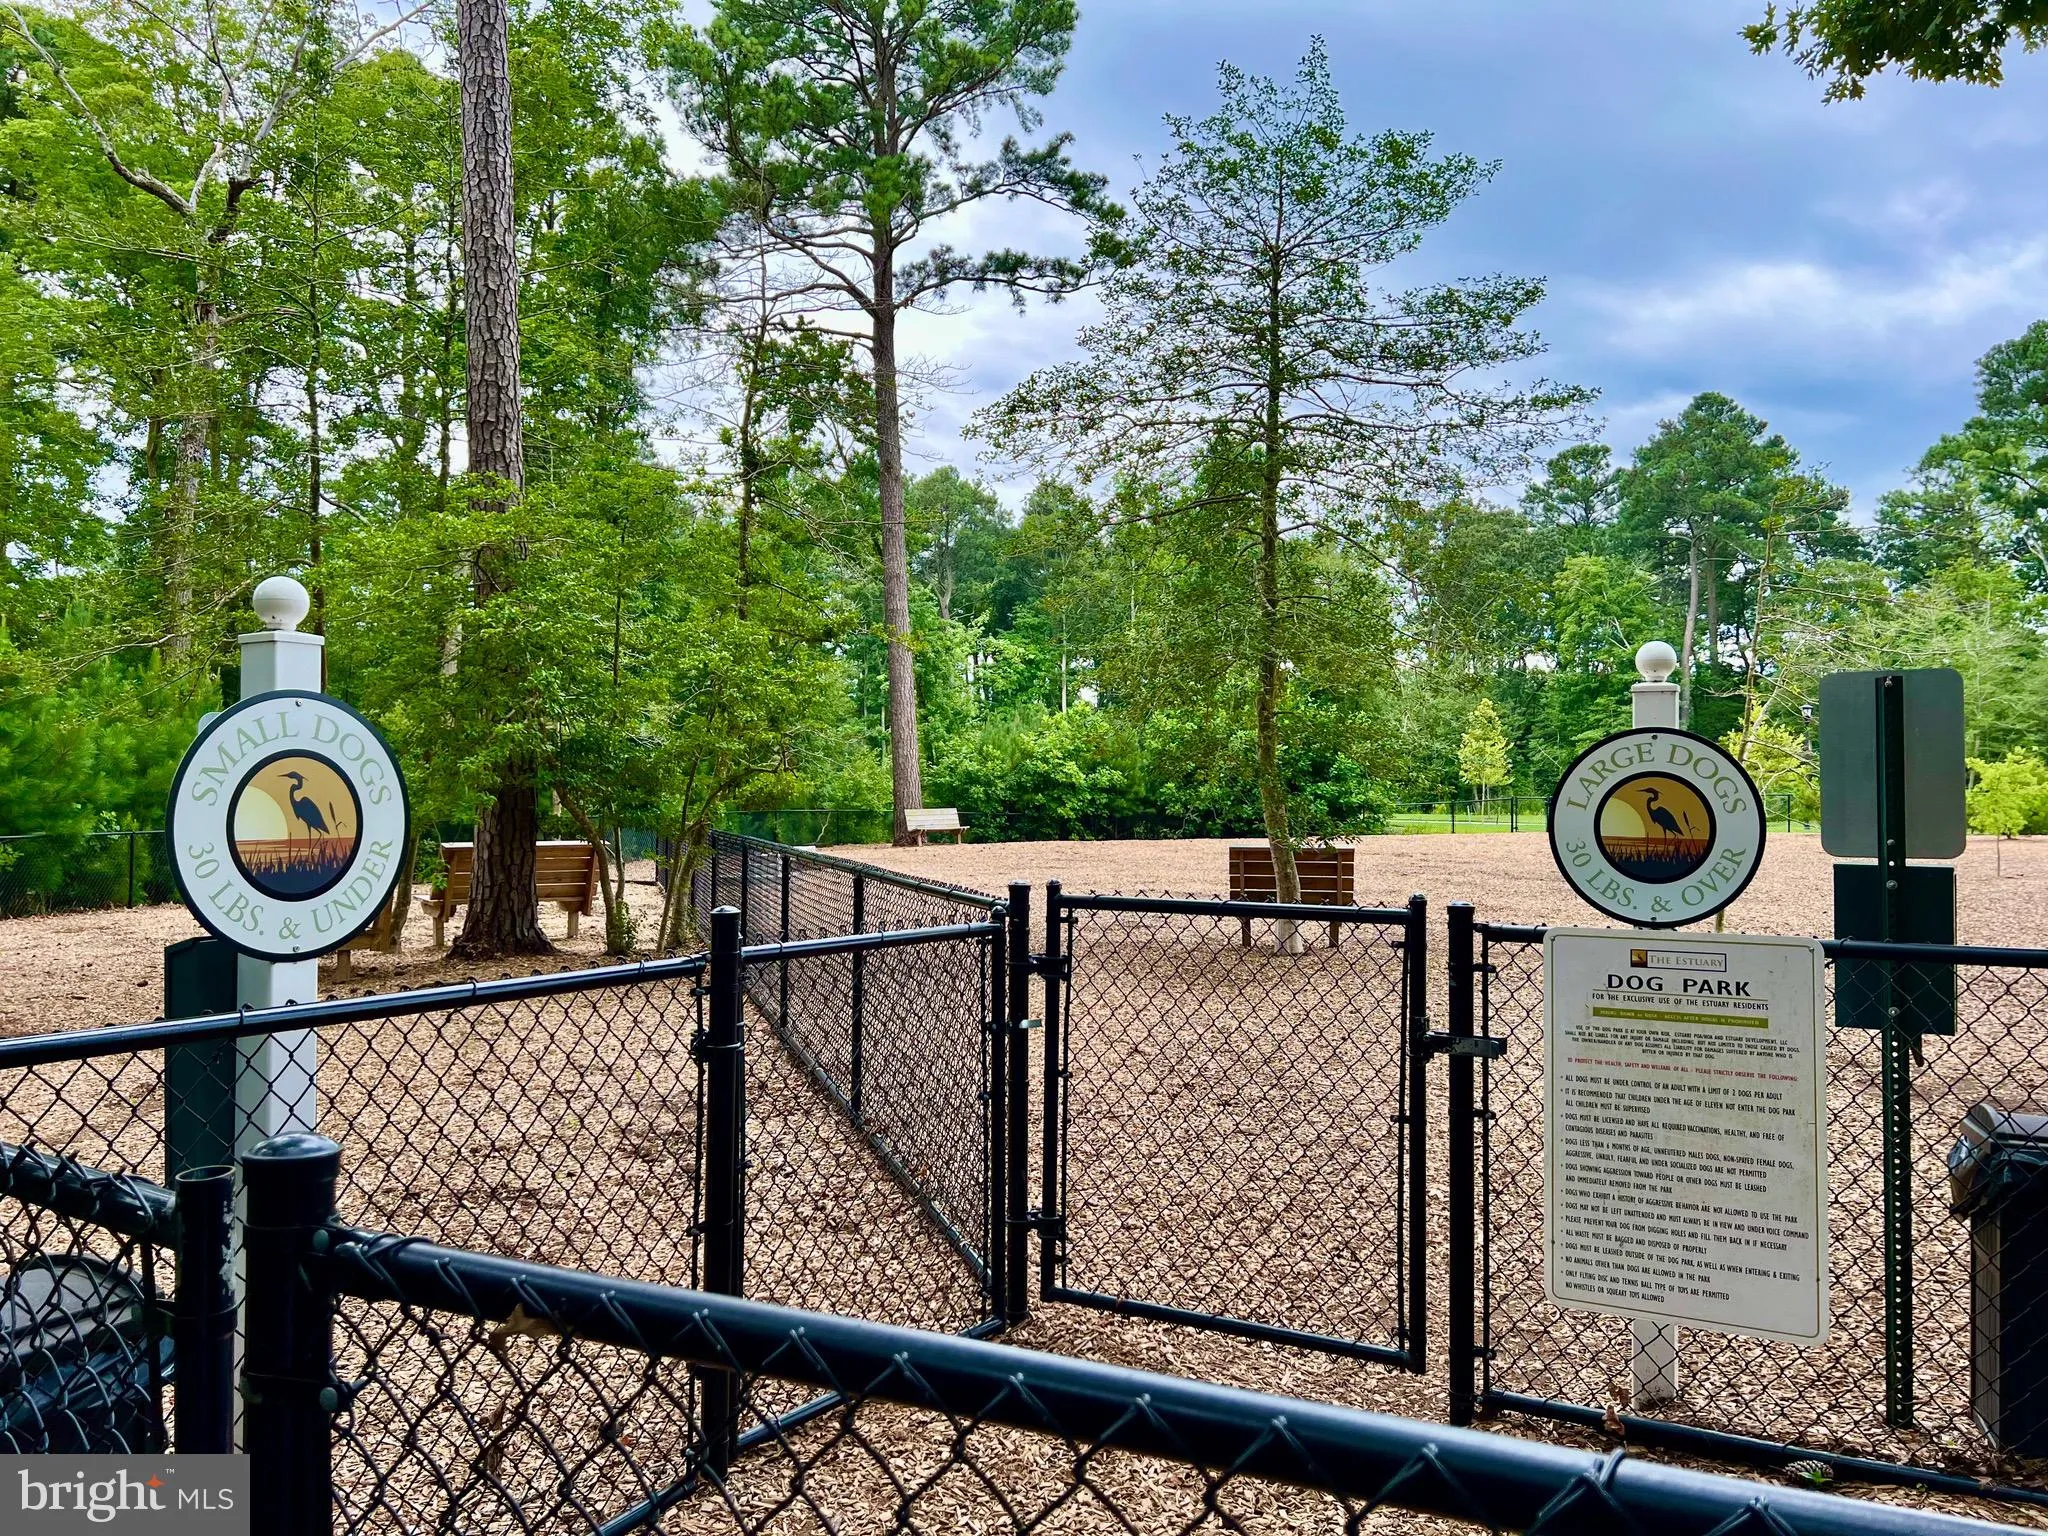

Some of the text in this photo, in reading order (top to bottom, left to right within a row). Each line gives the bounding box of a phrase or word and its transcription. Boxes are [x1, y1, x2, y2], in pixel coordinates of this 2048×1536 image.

[191, 711, 392, 806] SMALL DOGS
[1567, 742, 1747, 814] LARGE DOGS
[1566, 837, 1747, 913] 30 LBS. & OVER
[189, 840, 393, 940] 30 LBS. & UNDER
[1649, 954, 1724, 968] THE ESTUARY
[1607, 973, 1750, 997] DOG PARK
[1622, 994, 1654, 1003] EXCLUSIVE
[1686, 998, 1697, 1006] THE
[1702, 999, 1729, 1008] ESTUARY
[1733, 1002, 1768, 1010] RESIDENTS
[1577, 1088, 1612, 1098] RECOMMENDED
[1614, 1092, 1625, 1100] THAT
[1627, 1093, 1651, 1102] CHILDREN
[1653, 1096, 1670, 1104] UNDER
[1671, 1097, 1681, 1105] THE
[1683, 1098, 1693, 1106] AGE
[1695, 1099, 1701, 1107] OF
[1704, 1100, 1723, 1109] ELEVEN
[1725, 1102, 1735, 1110] NOT
[1737, 1103, 1754, 1112] ENTER
[1756, 1105, 1765, 1113] THE
[1768, 1106, 1779, 1114] DOG
[1782, 1108, 1795, 1116] PARK
[1589, 1076, 1601, 1084] MUST
[1612, 1078, 1629, 1086] UNDER
[1630, 1079, 1652, 1088] CONTROL
[1661, 1082, 1669, 1090] AN
[1670, 1083, 1686, 1091] ADULT
[1686, 1084, 1700, 1093] WITH
[1707, 1086, 1720, 1095] LIMIT
[1737, 1089, 1751, 1097] DOGS
[1753, 1090, 1764, 1099] PER
[1765, 1092, 1782, 1100] ADULT
[1575, 1100, 1598, 1108] CHILDREN
[1600, 1102, 1612, 1110] MUST
[1614, 1103, 1620, 1111] BE
[1622, 1104, 1650, 1114] SUPERVISED
[1564, 1112, 1577, 1120] DOGS
[1579, 1113, 1591, 1121] MUST
[1601, 1116, 1623, 1125] LICENSED
[1625, 1118, 1635, 1126] AND
[1637, 1119, 1649, 1127] HAVE
[1661, 1122, 1686, 1132] REQUIRED
[1686, 1124, 1721, 1135] VACCINATIONS,
[1724, 1128, 1747, 1138] HEALTHY,
[1749, 1130, 1760, 1139] AND
[1762, 1132, 1774, 1140] FREE
[1777, 1133, 1784, 1141] OF
[1564, 1137, 1577, 1145] DOGS
[1591, 1140, 1604, 1148] THAN
[1611, 1142, 1631, 1151] MONTHS
[1632, 1144, 1639, 1152] OF
[1653, 1147, 1686, 1157] UNNEUTERED
[1687, 1150, 1703, 1159] MALES
[1705, 1152, 1721, 1162] DOGS,
[1722, 1154, 1754, 1165] NON-SPAYED
[1756, 1158, 1775, 1167] FEMALE
[1778, 1160, 1794, 1170] DOGS,
[1565, 1162, 1577, 1170] DOGS
[1579, 1164, 1601, 1173] SHOWING
[1603, 1166, 1631, 1176] AGGRESSION
[1633, 1170, 1653, 1179] TOWARD
[1655, 1172, 1673, 1181] PEOPLE
[1676, 1175, 1683, 1183] OR
[1685, 1176, 1701, 1185] OTHER
[1703, 1178, 1717, 1187] DOGS
[1719, 1180, 1732, 1188] MUST
[1744, 1183, 1766, 1192] LEASHED
[1565, 1174, 1672, 1193] AND IMMEDIATELY REMOVED FROM THE PARK
[1565, 1201, 1577, 1209] DOGS
[1579, 1203, 1588, 1211] MAY
[1590, 1204, 1599, 1212] NOT
[1610, 1207, 1621, 1215] LEFT
[1623, 1208, 1654, 1219] UNATTENDED
[1656, 1213, 1666, 1221] AND
[1668, 1214, 1681, 1223] MUST
[1682, 1216, 1701, 1225] ALWAYS
[1703, 1218, 1709, 1226] BE
[1719, 1220, 1732, 1229] VIEW
[1733, 1222, 1745, 1231] AND
[1747, 1224, 1764, 1233] UNDER
[1765, 1226, 1780, 1235] VOICE
[1782, 1228, 1809, 1239] COMMAND
[1565, 1255, 1710, 1283] NO ANIMALS OTHER THAN DOGS ARE ALLOWED IN THE PARK
[1565, 1269, 1729, 1300] ONLY FLYING DISC AND TENNIS BALL TYPE OF TOYS ARE PERMITTED
[1572, 1282, 1595, 1292] WHISTLES
[1597, 1285, 1604, 1293] OR
[1606, 1287, 1626, 1297] SQUEAKY
[1628, 1290, 1639, 1299] TOYS
[1641, 1292, 1664, 1302] ALLOWED
